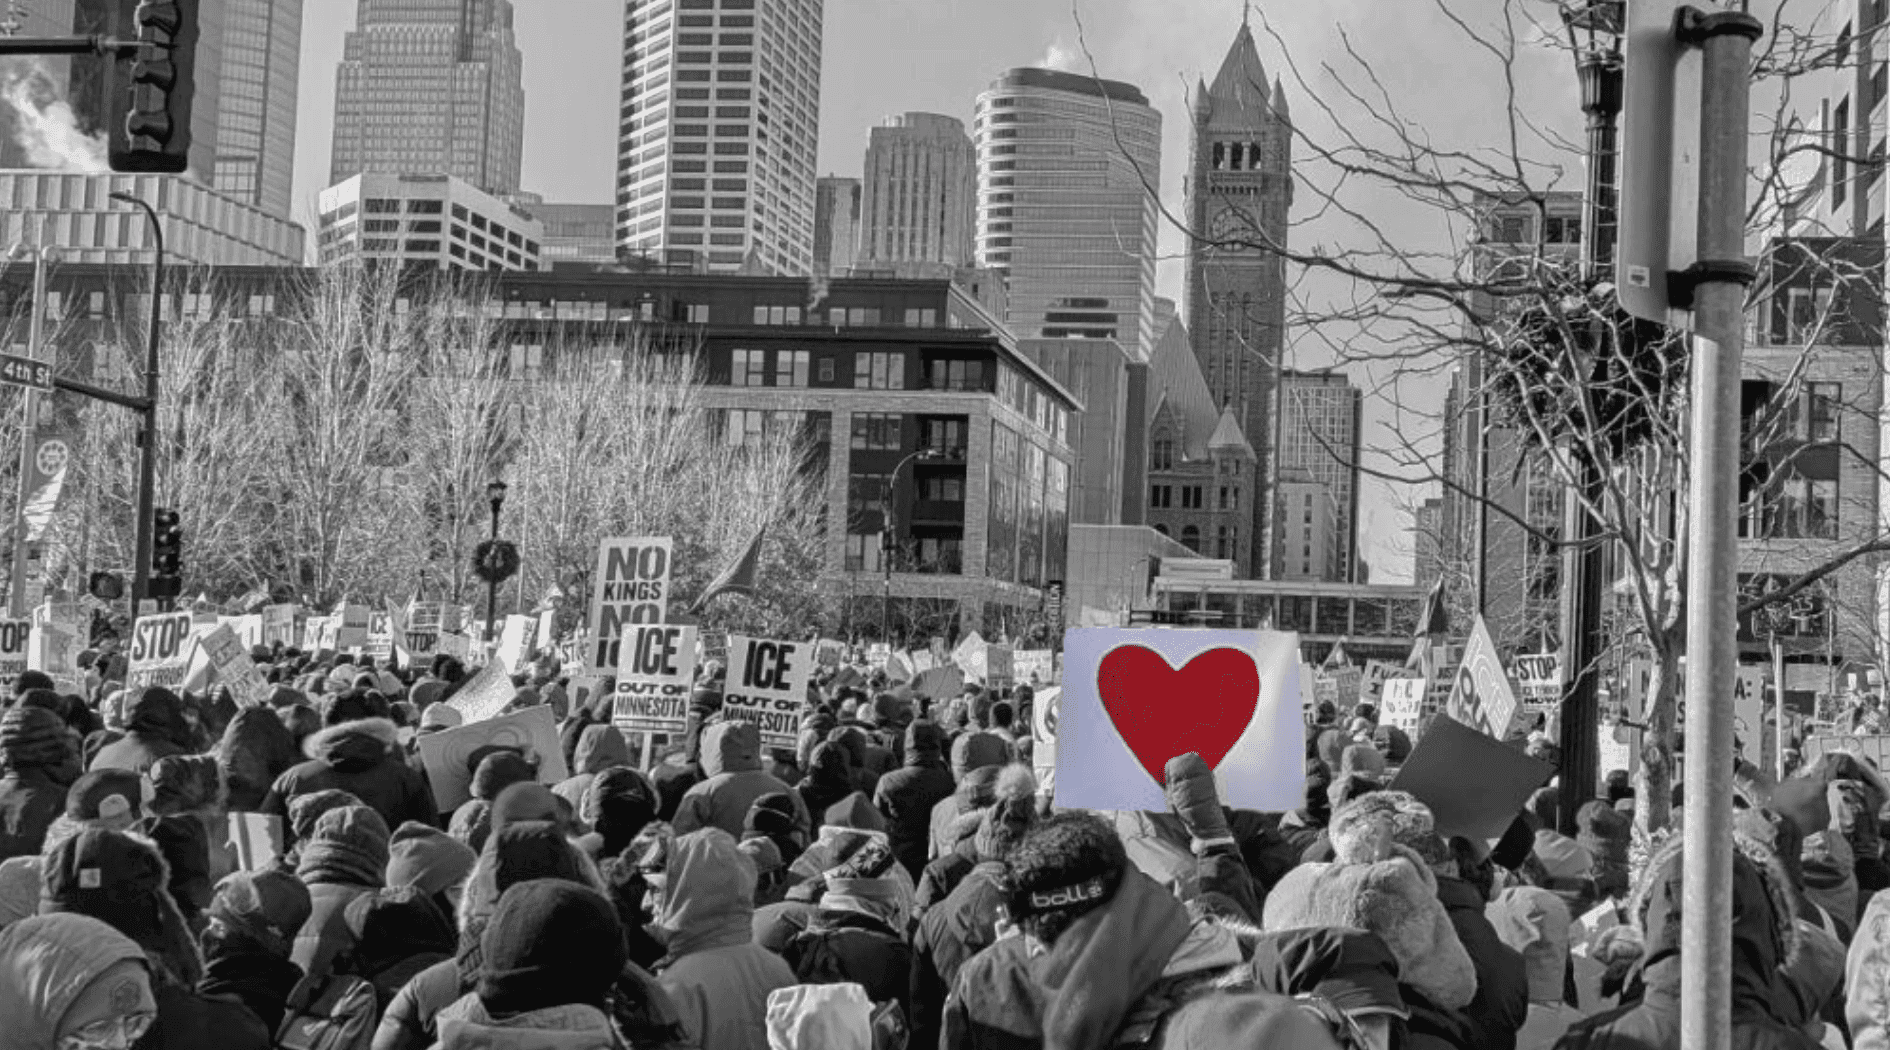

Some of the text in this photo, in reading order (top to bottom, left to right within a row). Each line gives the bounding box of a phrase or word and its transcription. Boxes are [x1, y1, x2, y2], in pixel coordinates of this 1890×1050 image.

[4, 361, 51, 385] 4th St
[606, 546, 666, 580] NO
[603, 582, 661, 601] KINGS
[132, 616, 190, 661] STOP
[632, 627, 681, 676] ICE
[743, 640, 795, 691] ICE
[1518, 657, 1557, 680] STOP
[618, 682, 688, 695] OUT OF
[616, 695, 687, 718] MINNESOTA
[726, 694, 799, 711] OUT OF
